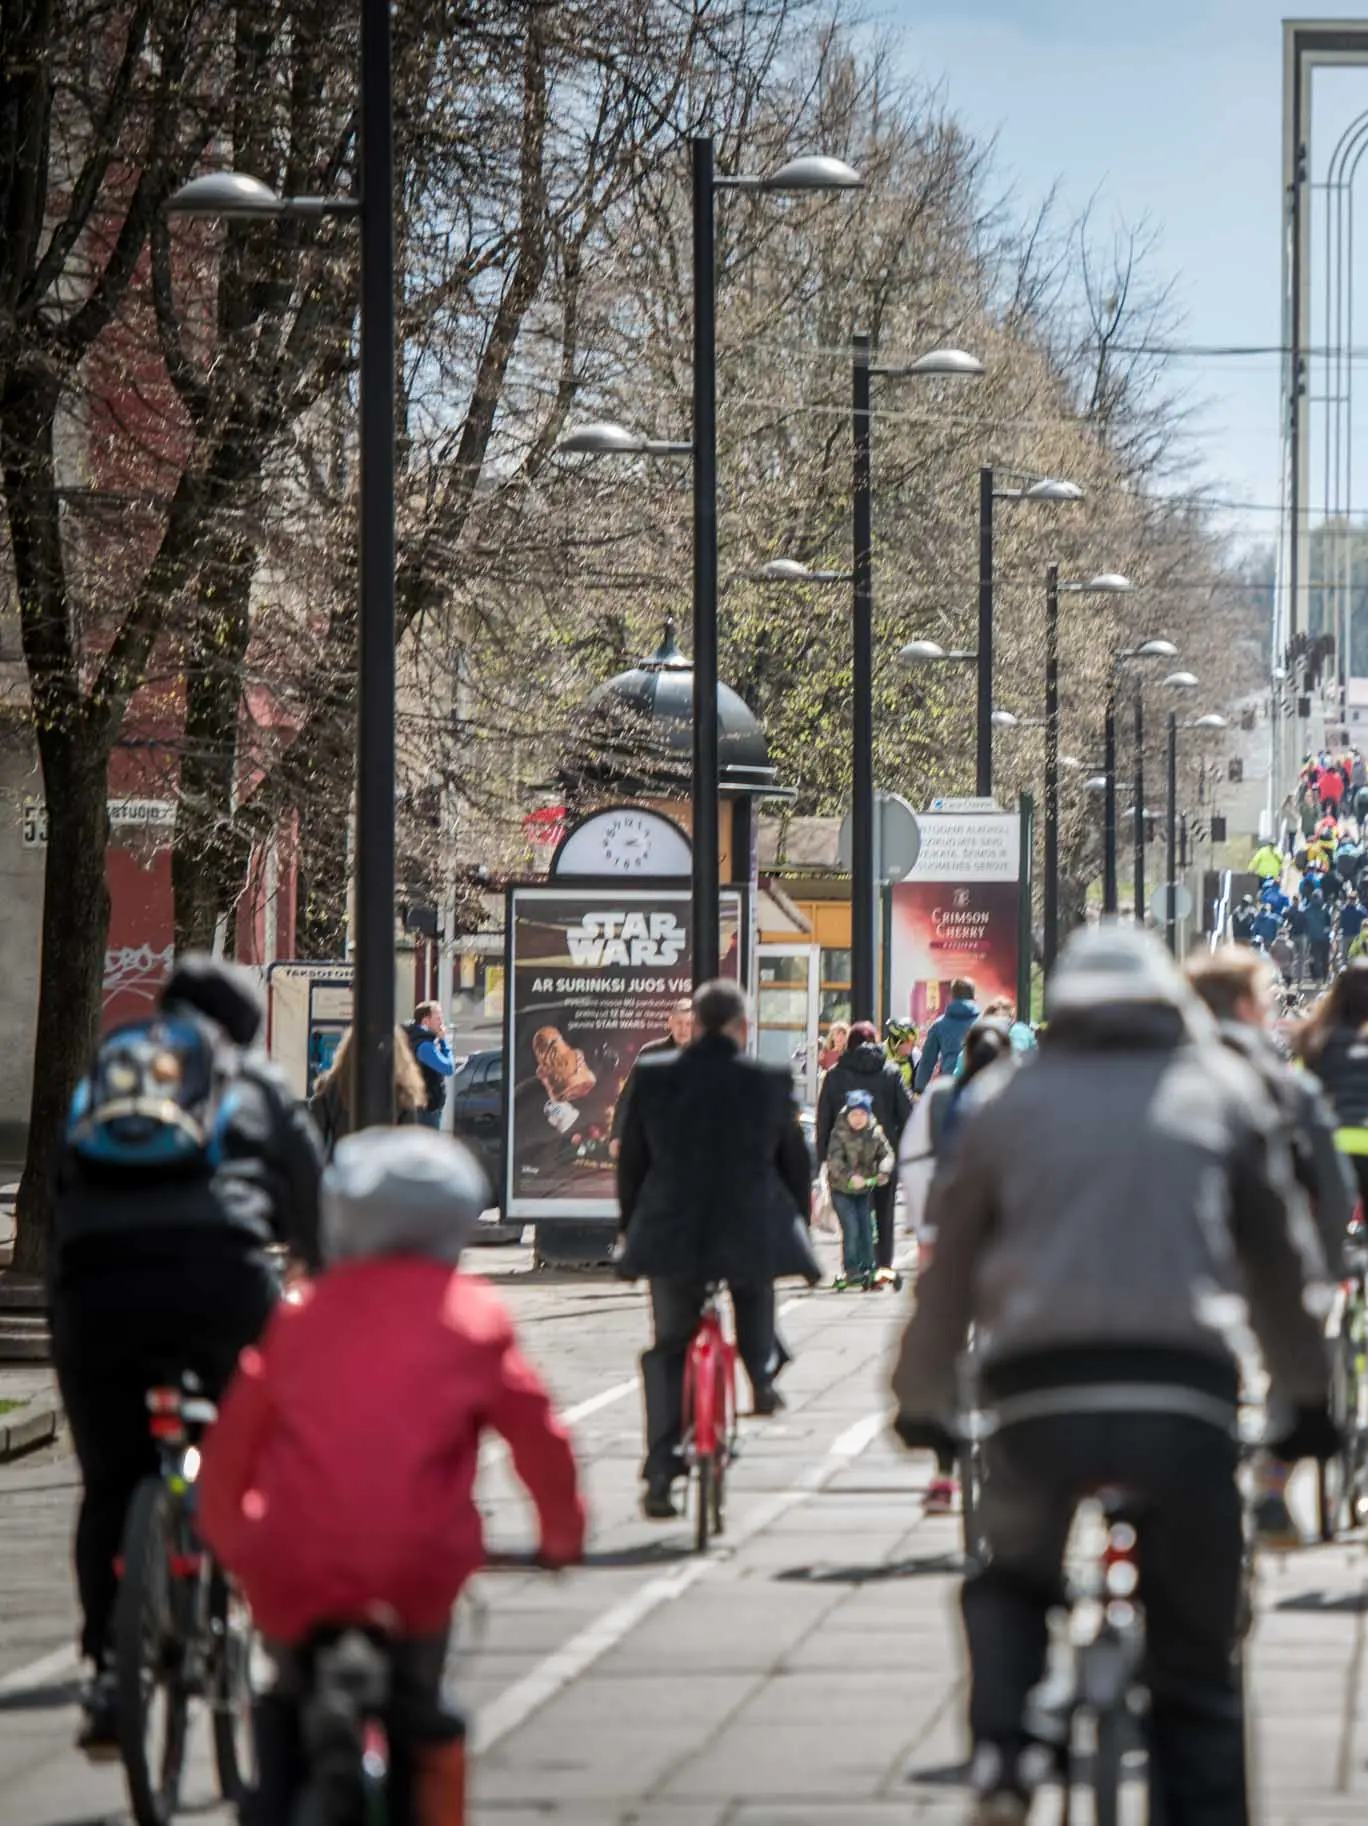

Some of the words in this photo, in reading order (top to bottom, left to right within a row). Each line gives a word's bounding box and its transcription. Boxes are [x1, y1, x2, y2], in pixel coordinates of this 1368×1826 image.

[931, 907, 990, 924] CRIMSON
[567, 912, 685, 939] STAR
[936, 923, 985, 939] CHERRY
[567, 938, 685, 966] WARS
[532, 978, 552, 992] AR
[556, 978, 625, 992] SURINKSI
[628, 978, 665, 992] JUOS
[667, 978, 692, 992] VIS
